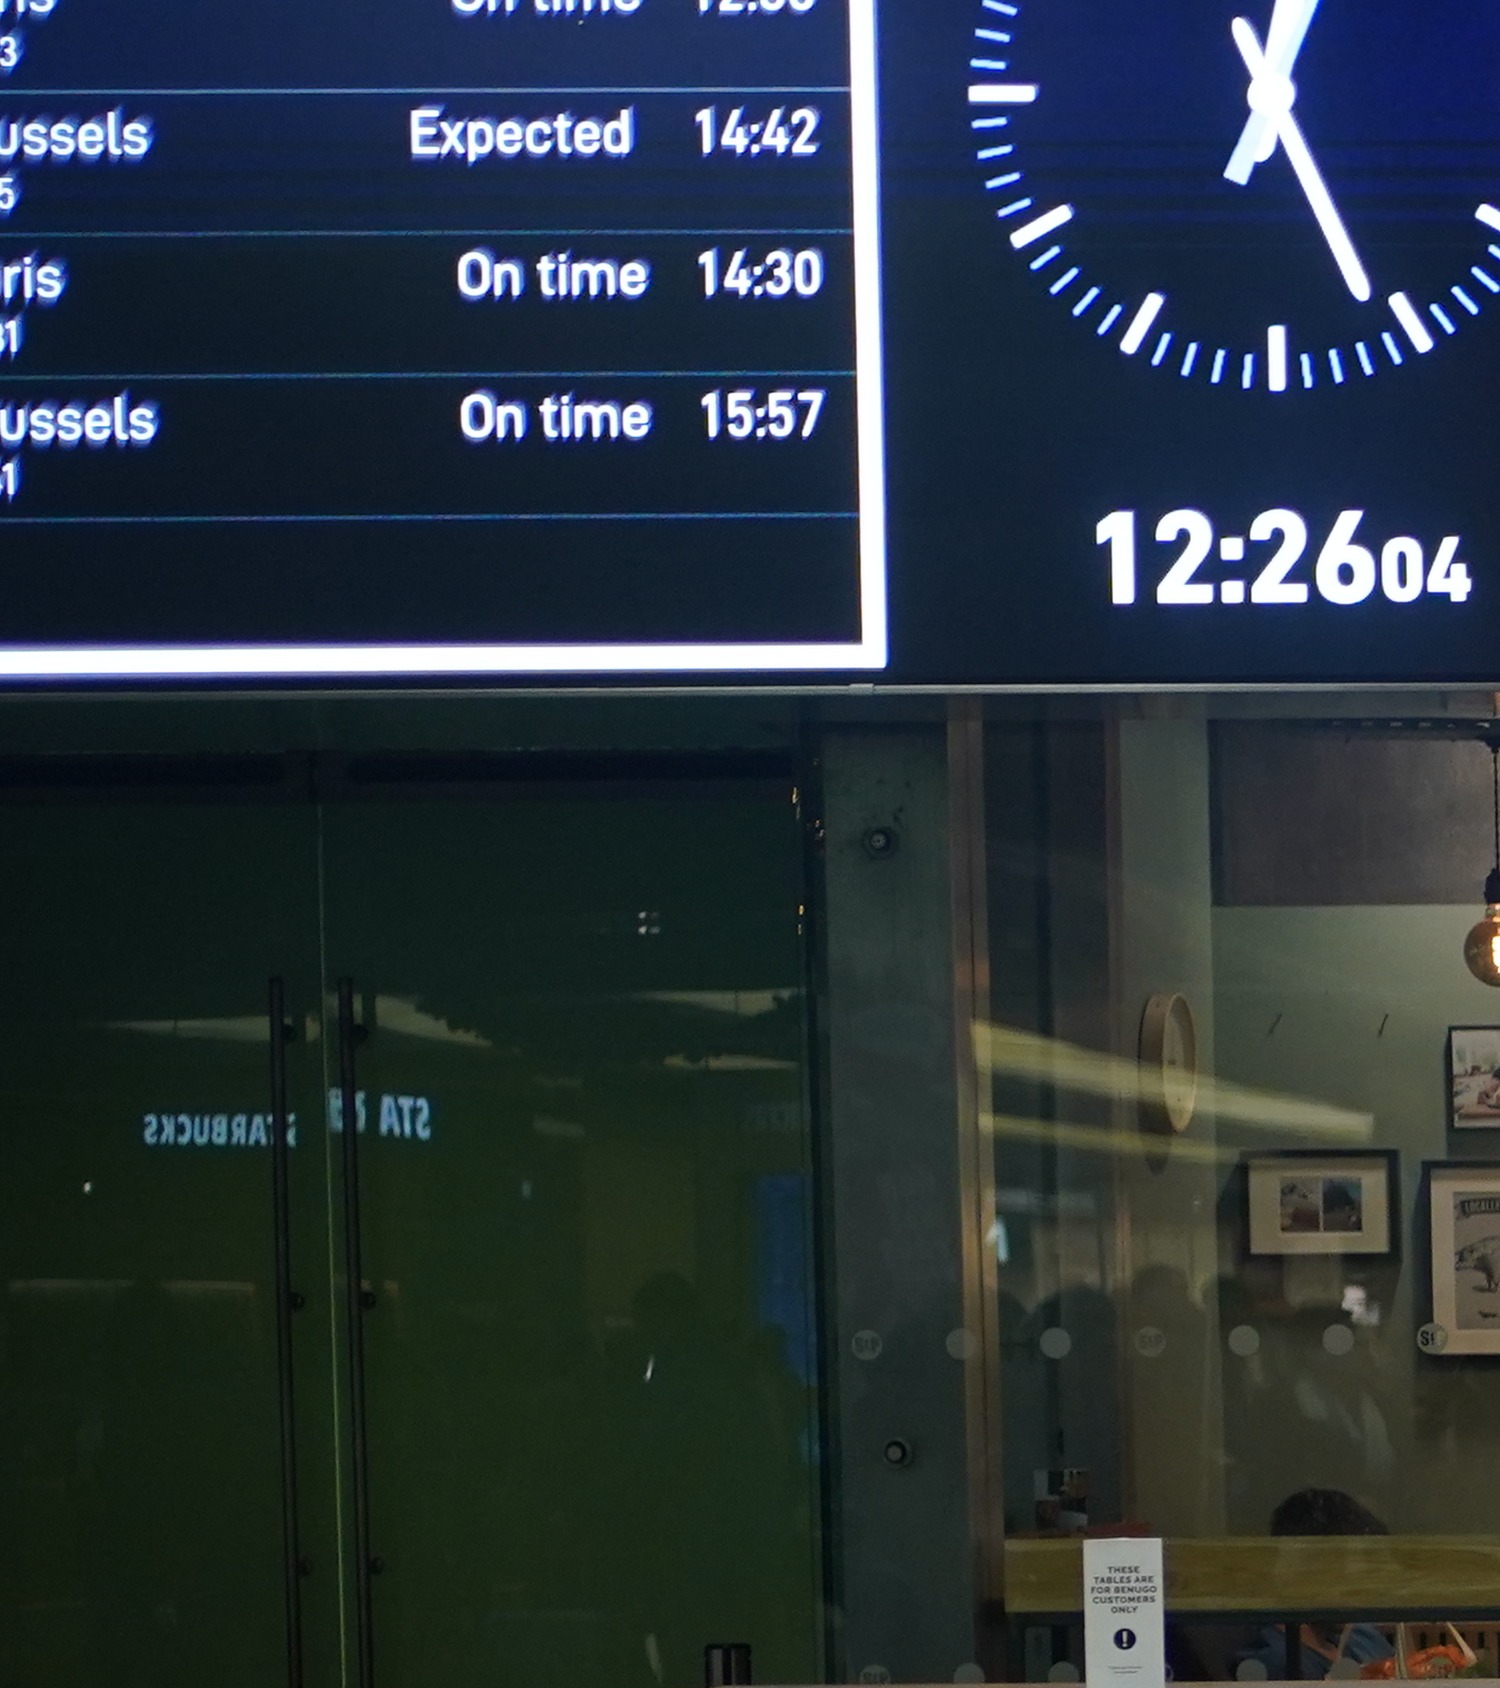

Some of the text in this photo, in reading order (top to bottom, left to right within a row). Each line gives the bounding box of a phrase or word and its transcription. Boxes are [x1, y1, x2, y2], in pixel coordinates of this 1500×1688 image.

[411, 109, 631, 162] Expected
[695, 108, 817, 154] 14:42
[458, 251, 521, 296] On
[536, 253, 647, 296] time
[698, 250, 820, 296] 14:30
[460, 393, 524, 438] On
[539, 395, 650, 438] time
[701, 391, 824, 437] 15:57
[1107, 1566, 1141, 1574] THESE
[1093, 1575, 1155, 1585] TABLES ARE
[1090, 1585, 1158, 1594] FOR BENUGO
[1092, 1596, 1156, 1604] CUSTOMERS
[1110, 1606, 1139, 1614] ONLY
